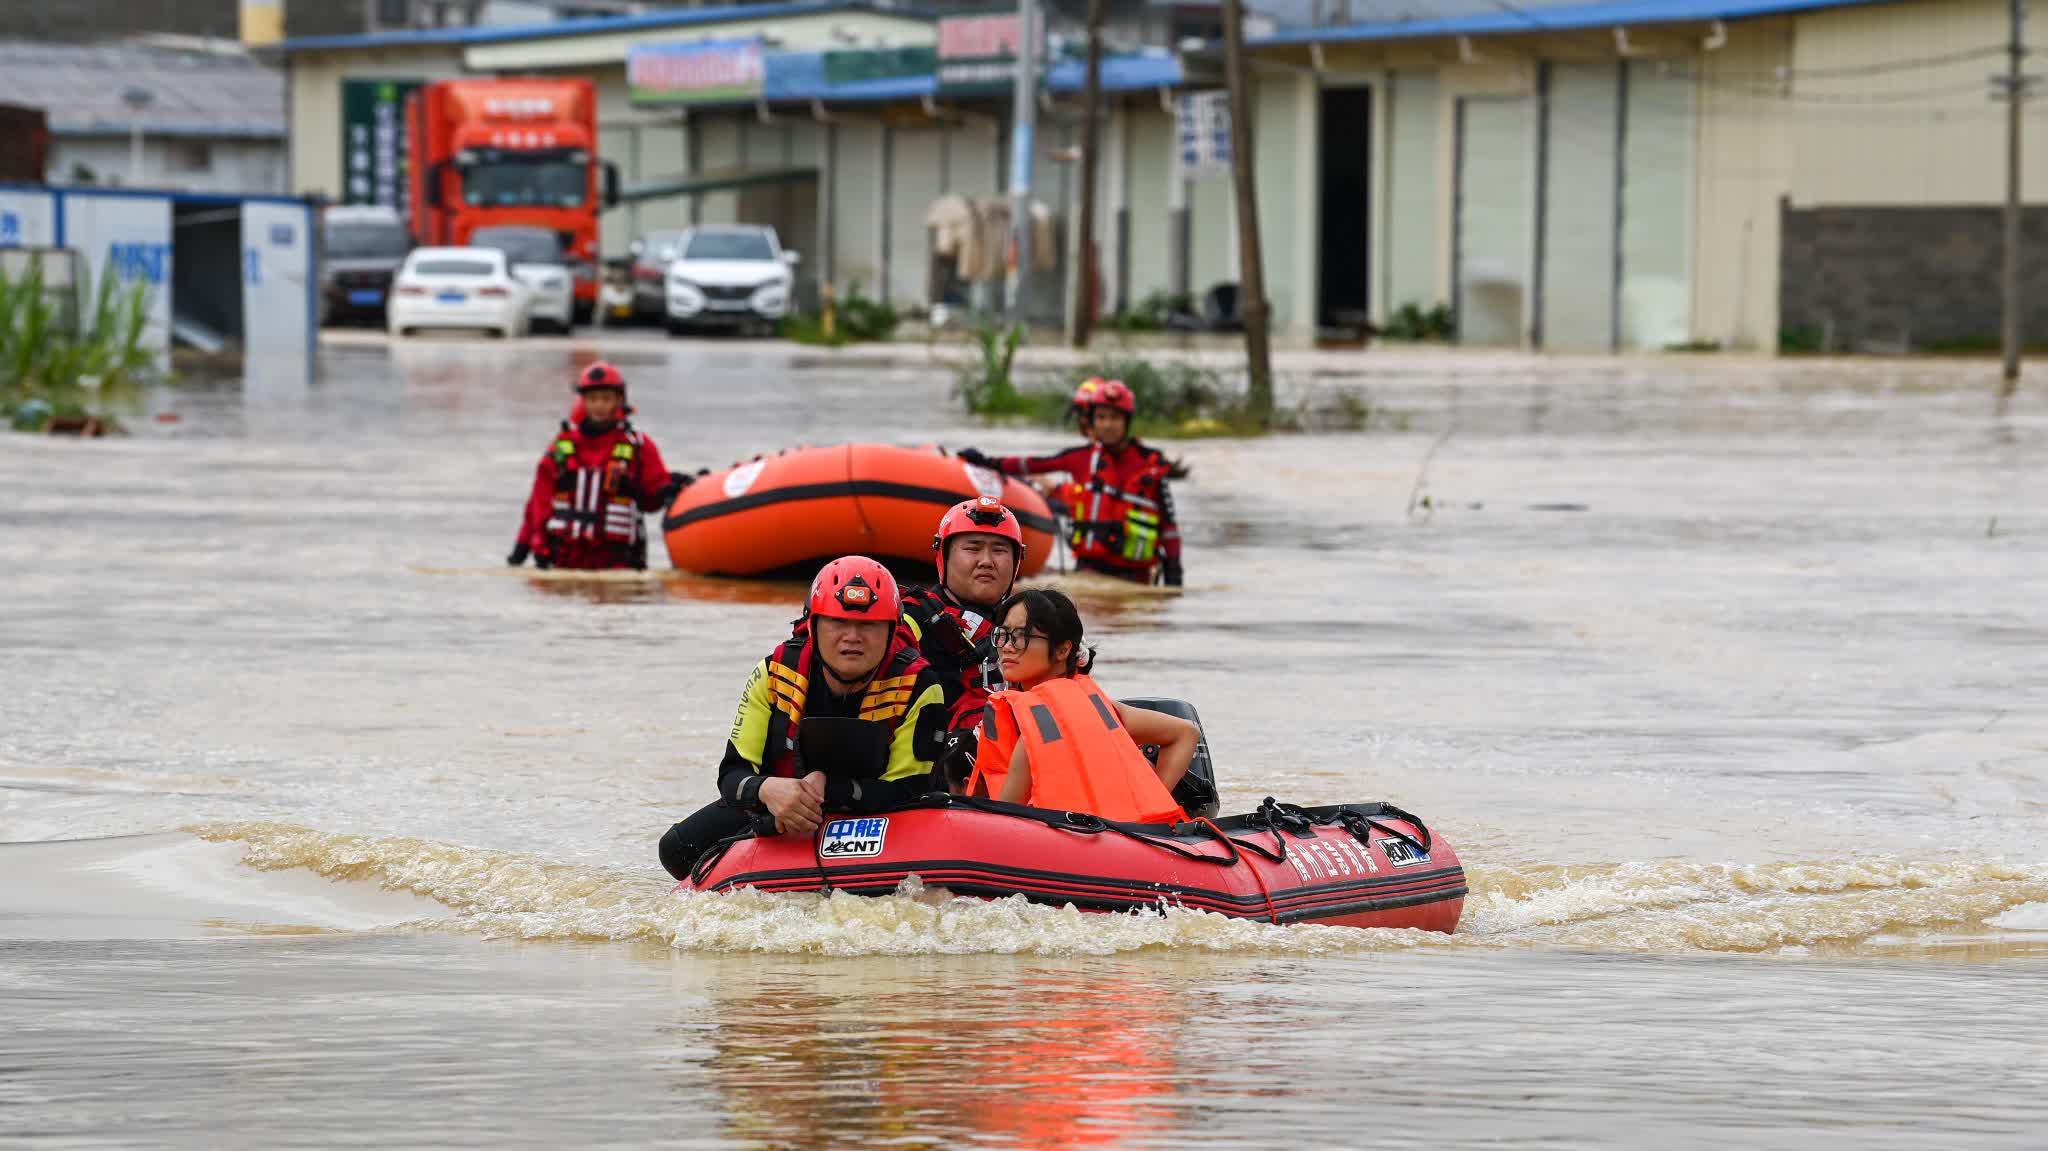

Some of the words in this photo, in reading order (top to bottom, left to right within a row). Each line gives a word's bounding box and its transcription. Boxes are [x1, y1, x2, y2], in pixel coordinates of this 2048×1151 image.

[731, 666, 762, 739] RESCUE
[826, 819, 884, 839] 中艇
[844, 840, 878, 852] CNT
